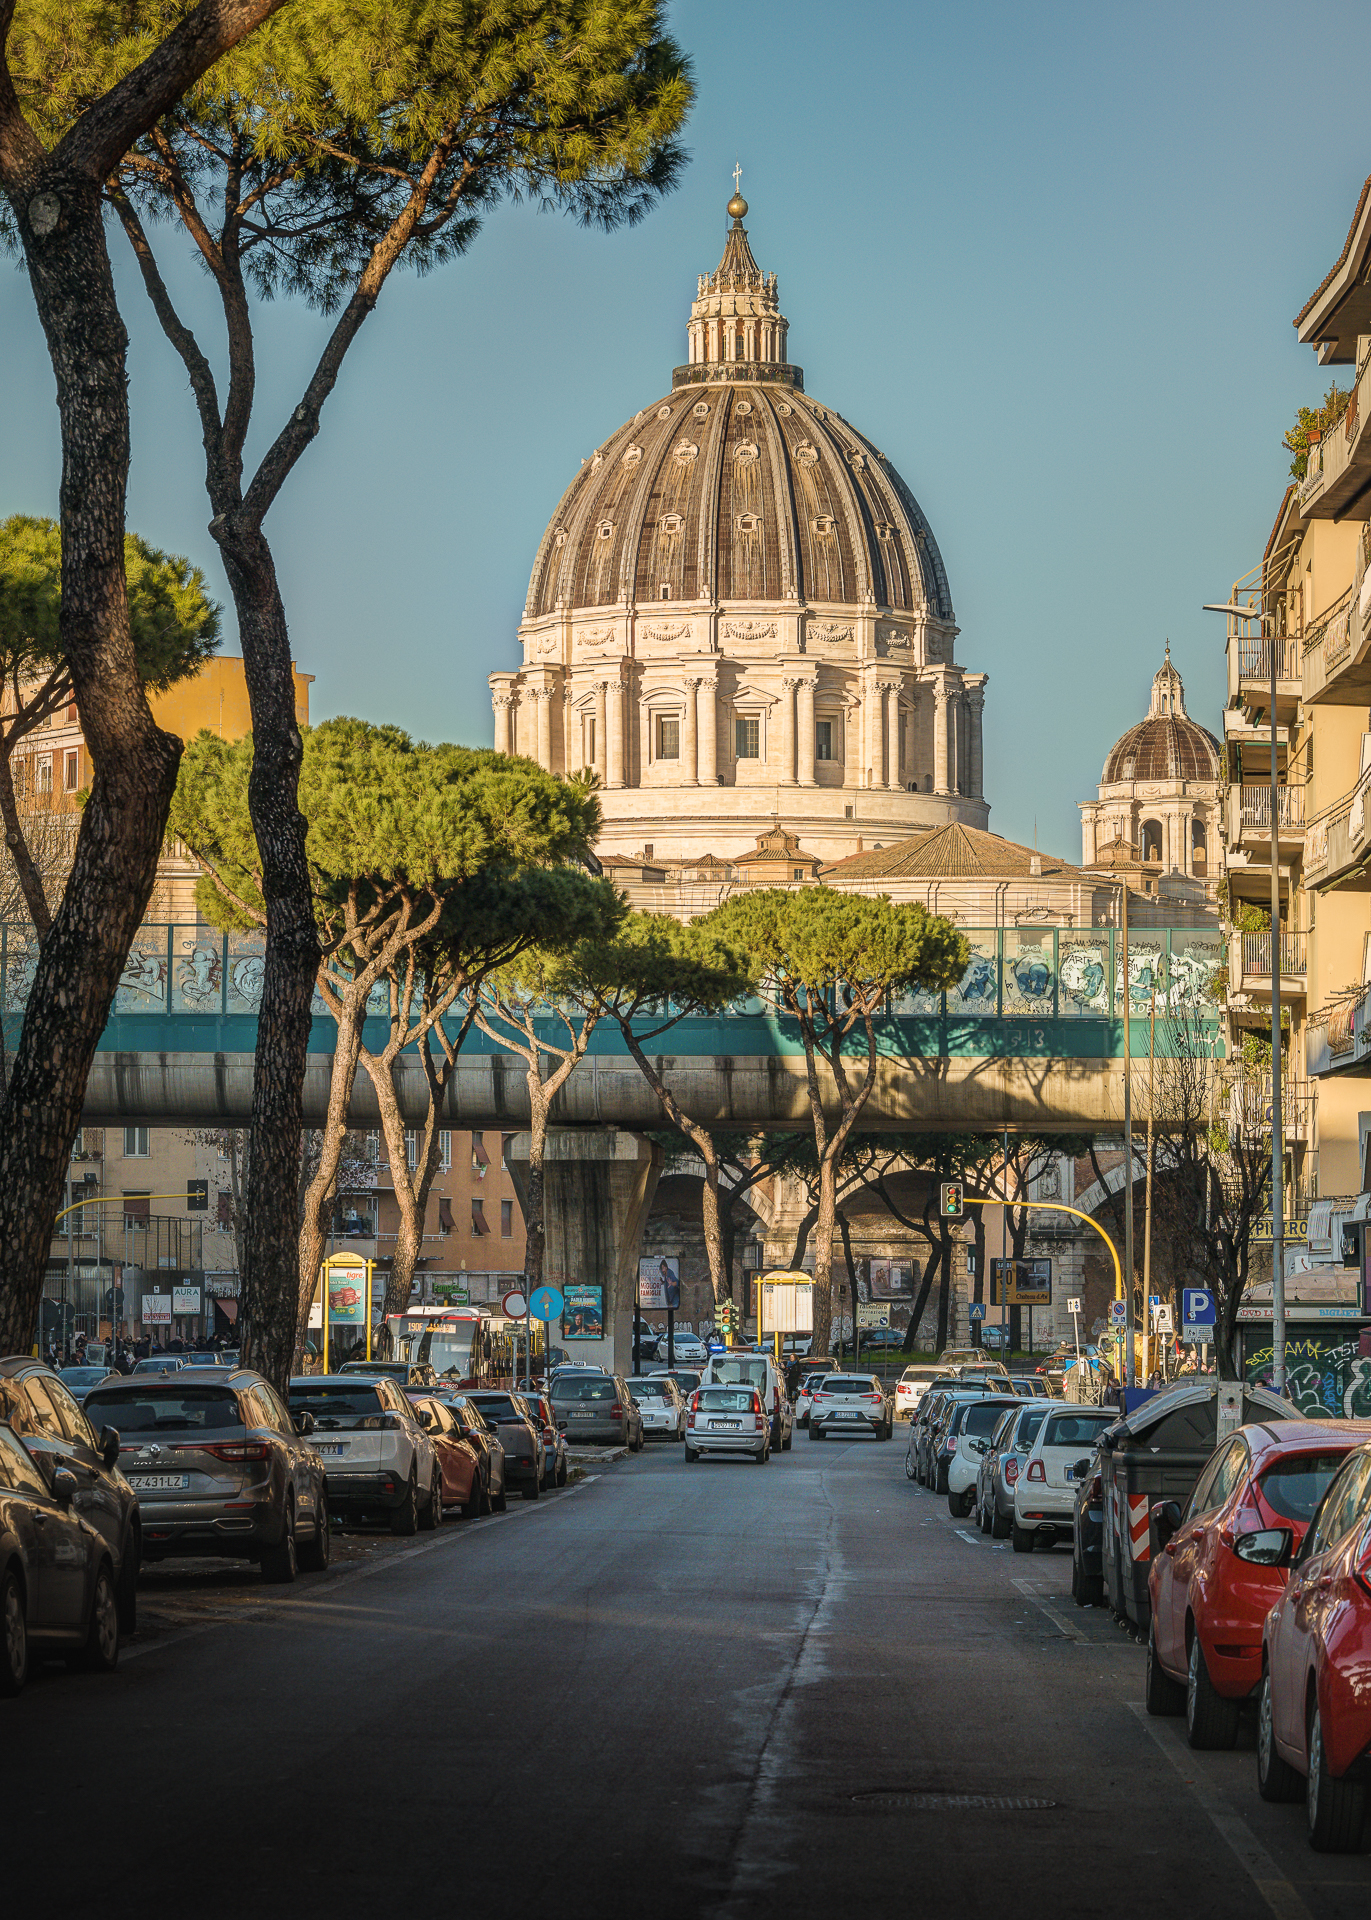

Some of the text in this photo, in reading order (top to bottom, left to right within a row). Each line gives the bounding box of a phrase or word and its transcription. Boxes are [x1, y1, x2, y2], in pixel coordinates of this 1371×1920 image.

[346, 1271, 364, 1281] tigre
[175, 1288, 199, 1296] AURA
[1190, 1293, 1209, 1321] P
